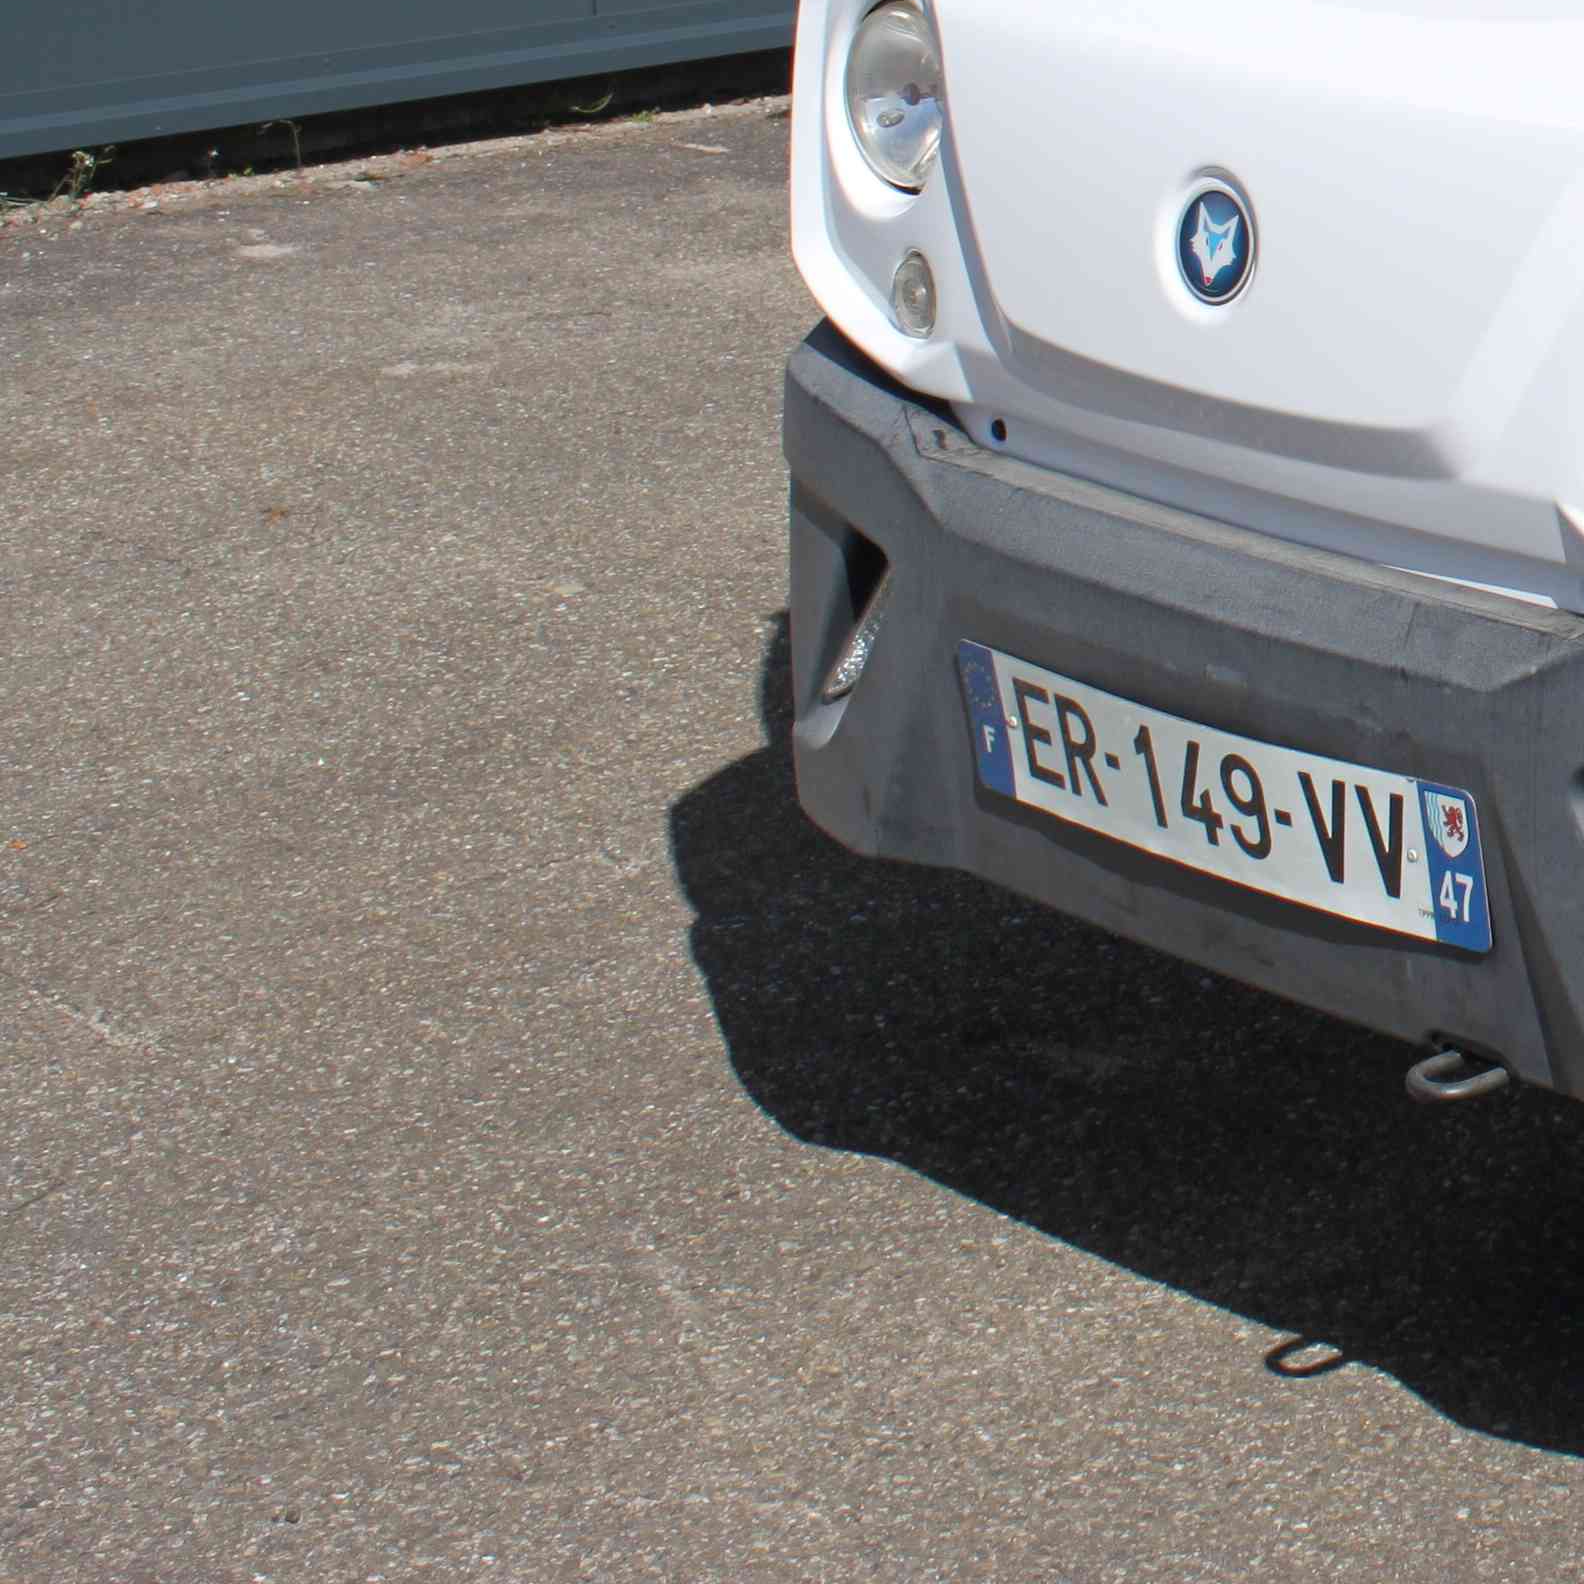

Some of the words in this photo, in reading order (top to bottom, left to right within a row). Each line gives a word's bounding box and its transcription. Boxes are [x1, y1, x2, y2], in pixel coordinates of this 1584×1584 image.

[983, 724, 996, 754] F
[1012, 677, 1404, 900] ER-149-VV
[1440, 870, 1473, 923] 47
